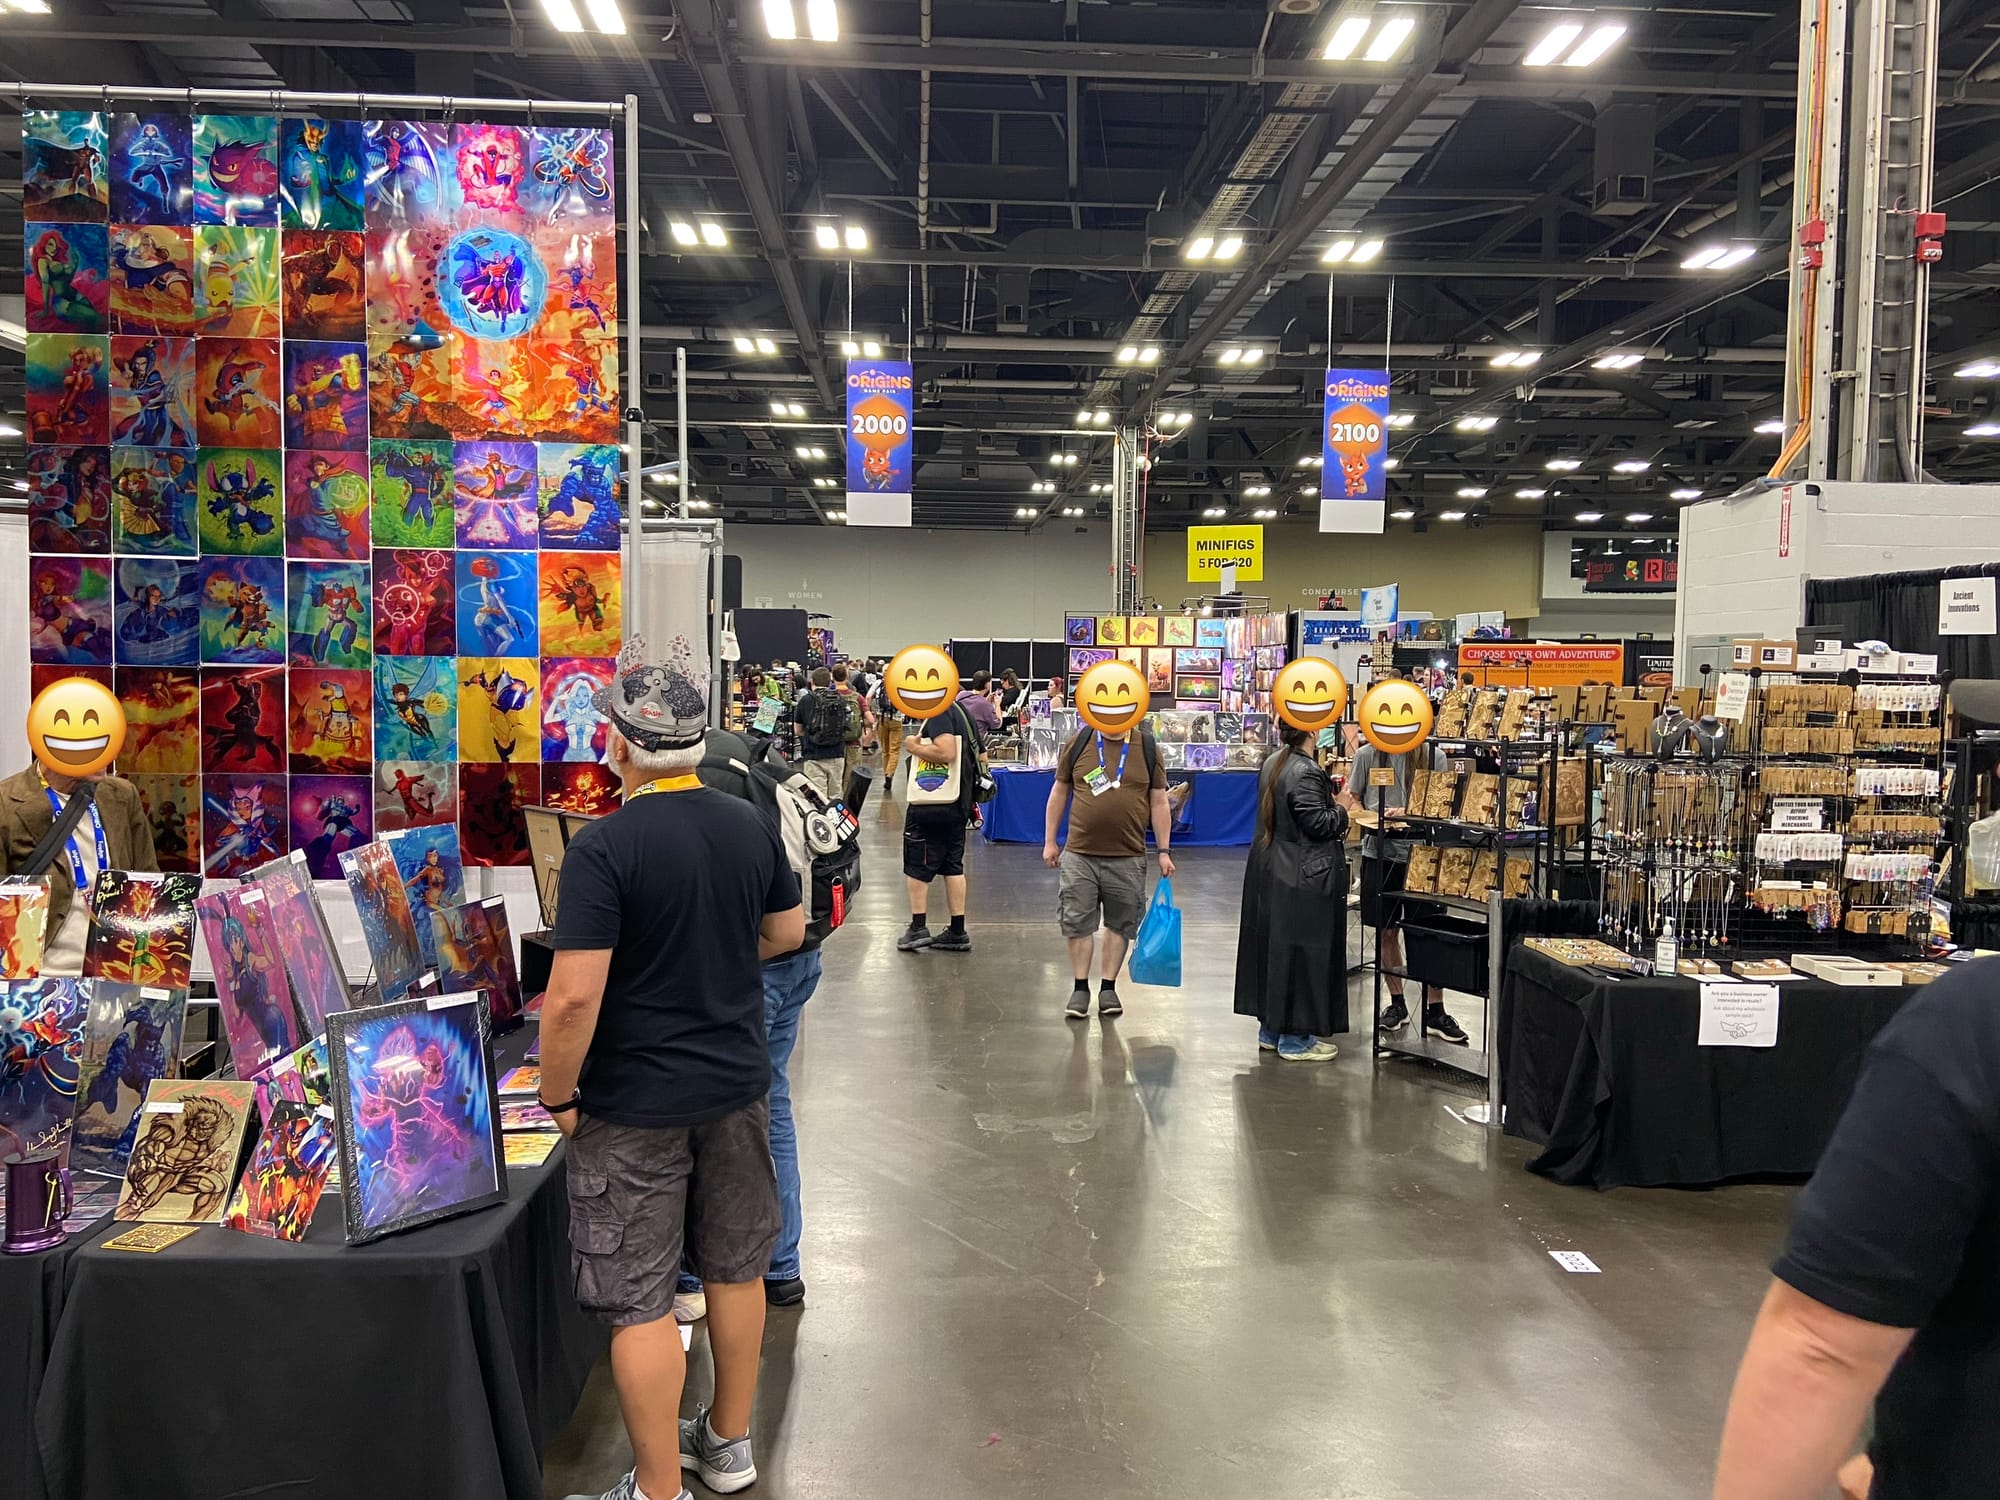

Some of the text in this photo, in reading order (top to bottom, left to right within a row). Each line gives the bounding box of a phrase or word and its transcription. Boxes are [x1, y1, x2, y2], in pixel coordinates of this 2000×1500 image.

[852, 414, 907, 435] 2000
[1331, 423, 1380, 443] 2100
[1196, 539, 1255, 551] MINIFIGS
[1199, 558, 1206, 568] 5
[1953, 591, 1974, 600] Ancient
[1467, 650, 1506, 659] CHOOSE
[1508, 650, 1532, 659] YOUR
[1535, 650, 1556, 659] OWN
